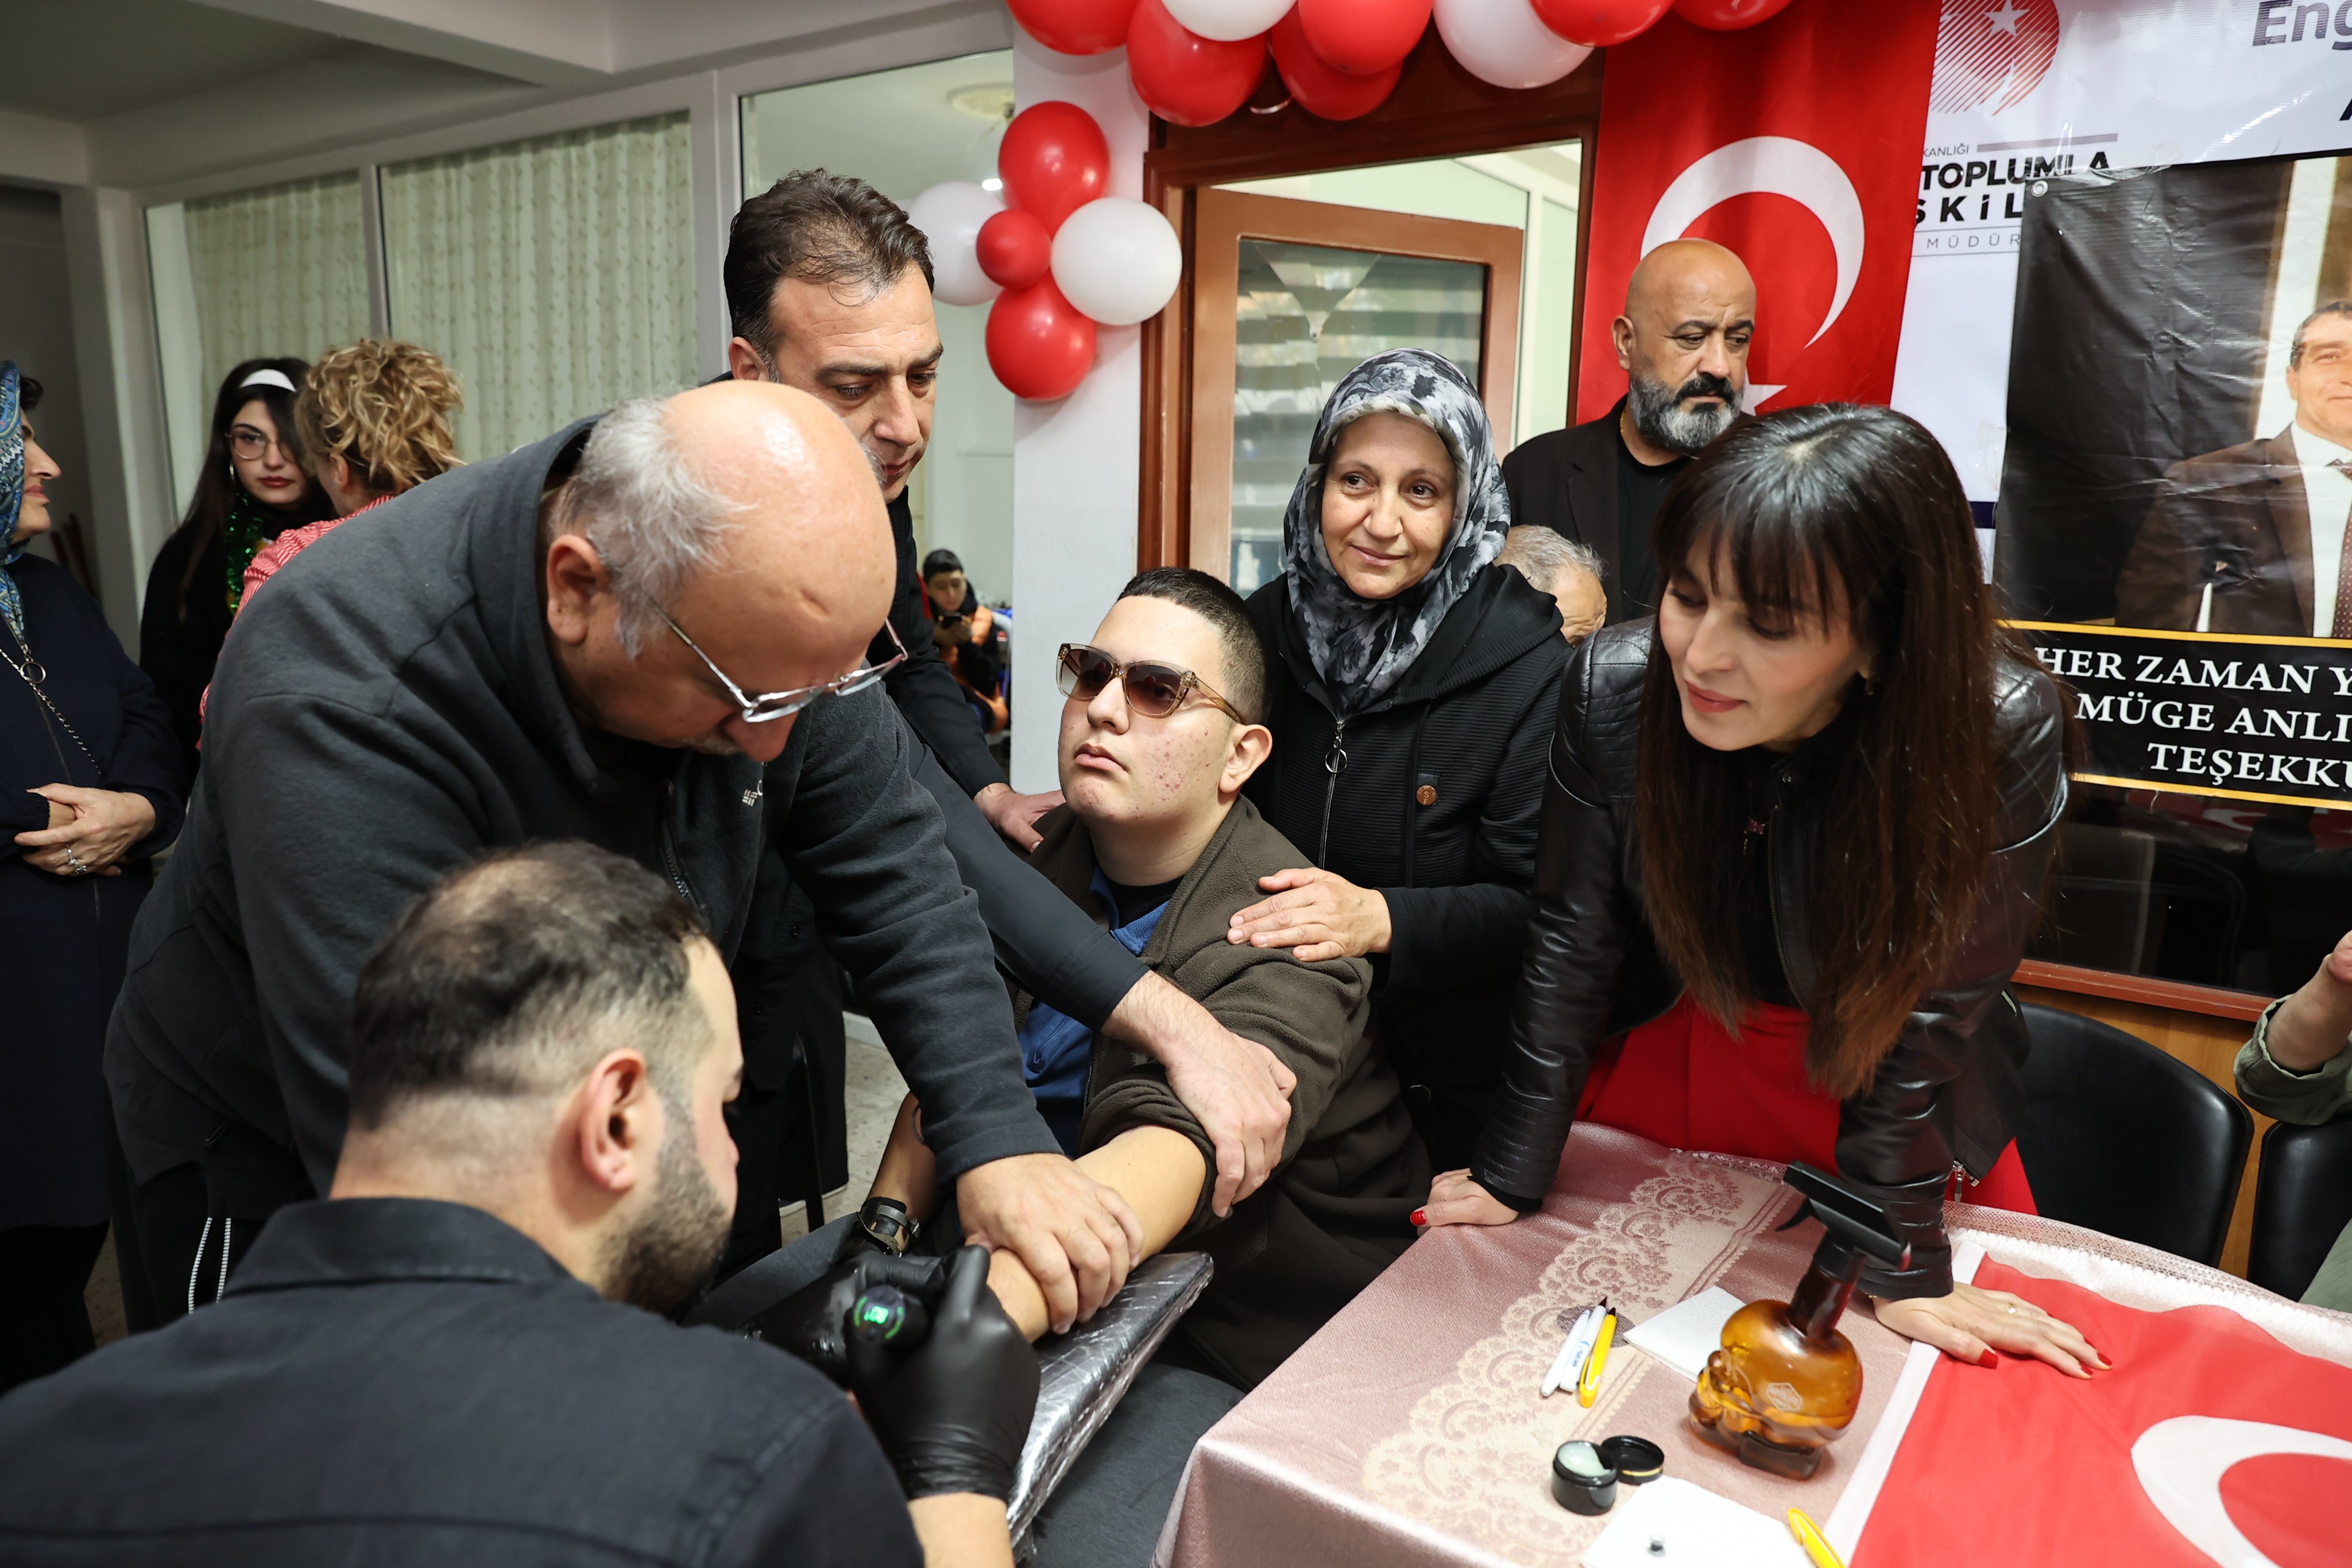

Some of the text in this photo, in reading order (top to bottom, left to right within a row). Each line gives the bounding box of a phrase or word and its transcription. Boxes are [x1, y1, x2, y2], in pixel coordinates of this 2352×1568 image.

[1927, 233, 2021, 249] MÜDÜR
[2034, 646, 2126, 681] HER
[2135, 655, 2319, 694] ZAMAN
[2074, 691, 2215, 732] MÜGE
